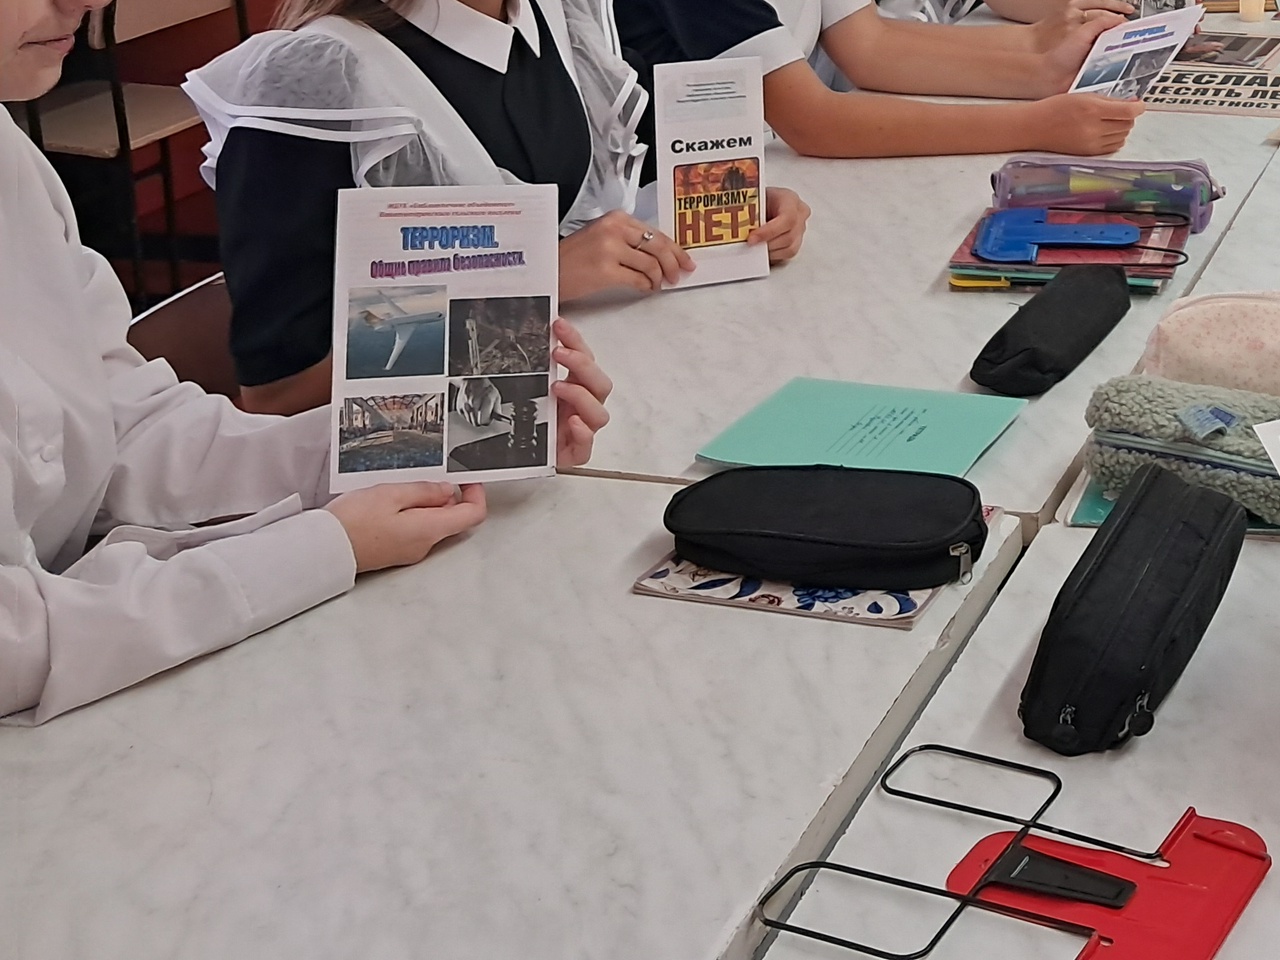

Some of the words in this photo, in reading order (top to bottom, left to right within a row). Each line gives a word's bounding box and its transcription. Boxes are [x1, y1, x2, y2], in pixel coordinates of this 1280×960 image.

[670, 135, 753, 154] Скажем
[677, 203, 757, 246] НЕТ!
[370, 260, 407, 279] Общие
[407, 256, 452, 277] правила
